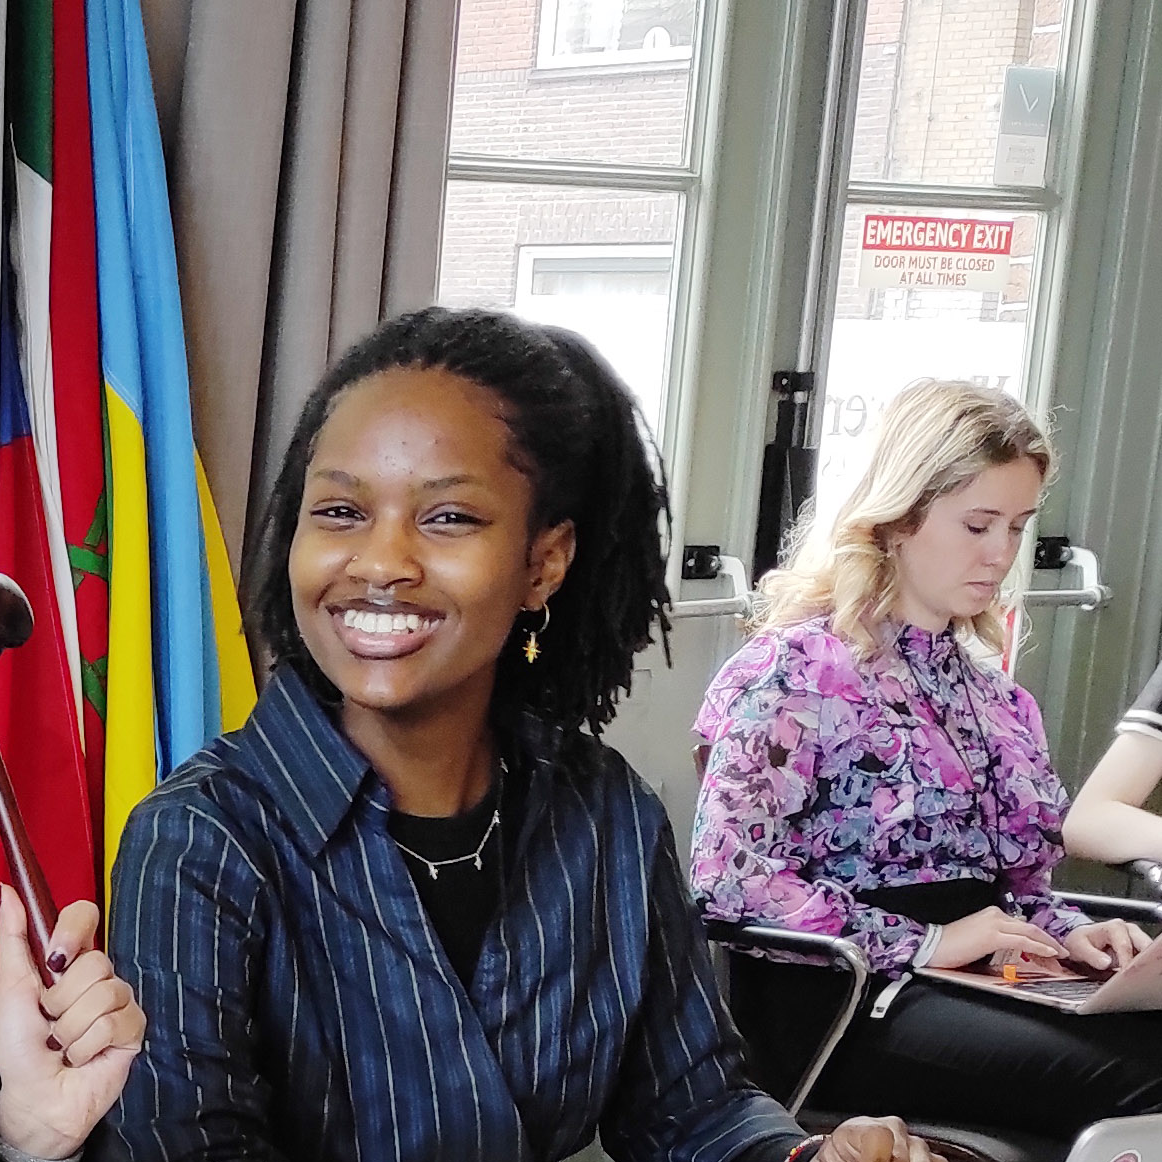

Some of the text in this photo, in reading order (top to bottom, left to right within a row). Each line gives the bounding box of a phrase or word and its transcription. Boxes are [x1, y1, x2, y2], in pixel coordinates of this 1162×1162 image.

[865, 219, 1010, 250] EMERGENCY EXIT
[874, 255, 995, 272] DOOR MUST BE CLOSED
[899, 271, 967, 286] AT ALL TIMES
